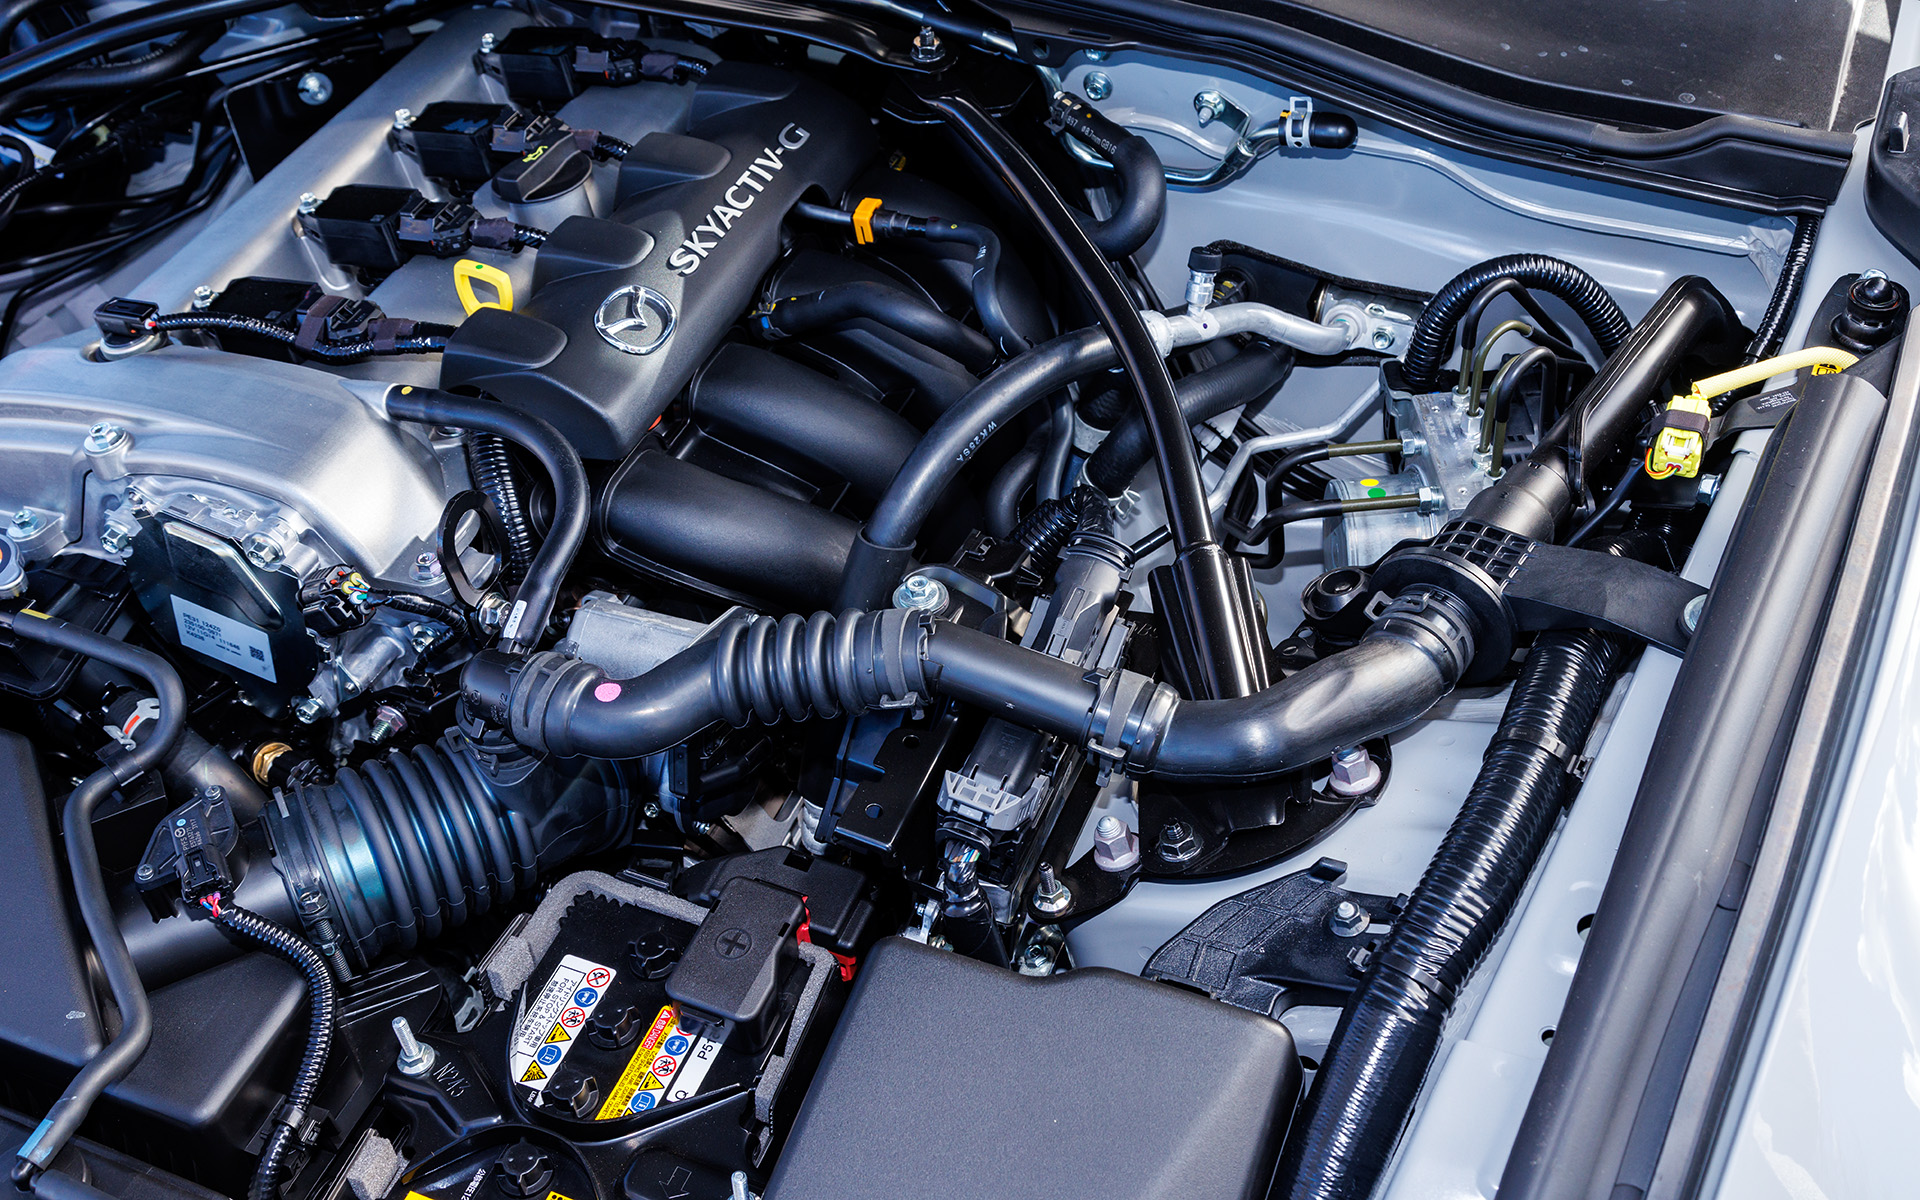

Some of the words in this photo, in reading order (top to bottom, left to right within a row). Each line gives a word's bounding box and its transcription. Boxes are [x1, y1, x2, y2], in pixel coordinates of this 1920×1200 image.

[669, 122, 811, 275] SKYACTIV-G
[556, 977, 570, 993] FOR
[543, 993, 559, 1014] STOP
[523, 1020, 542, 1045] START
